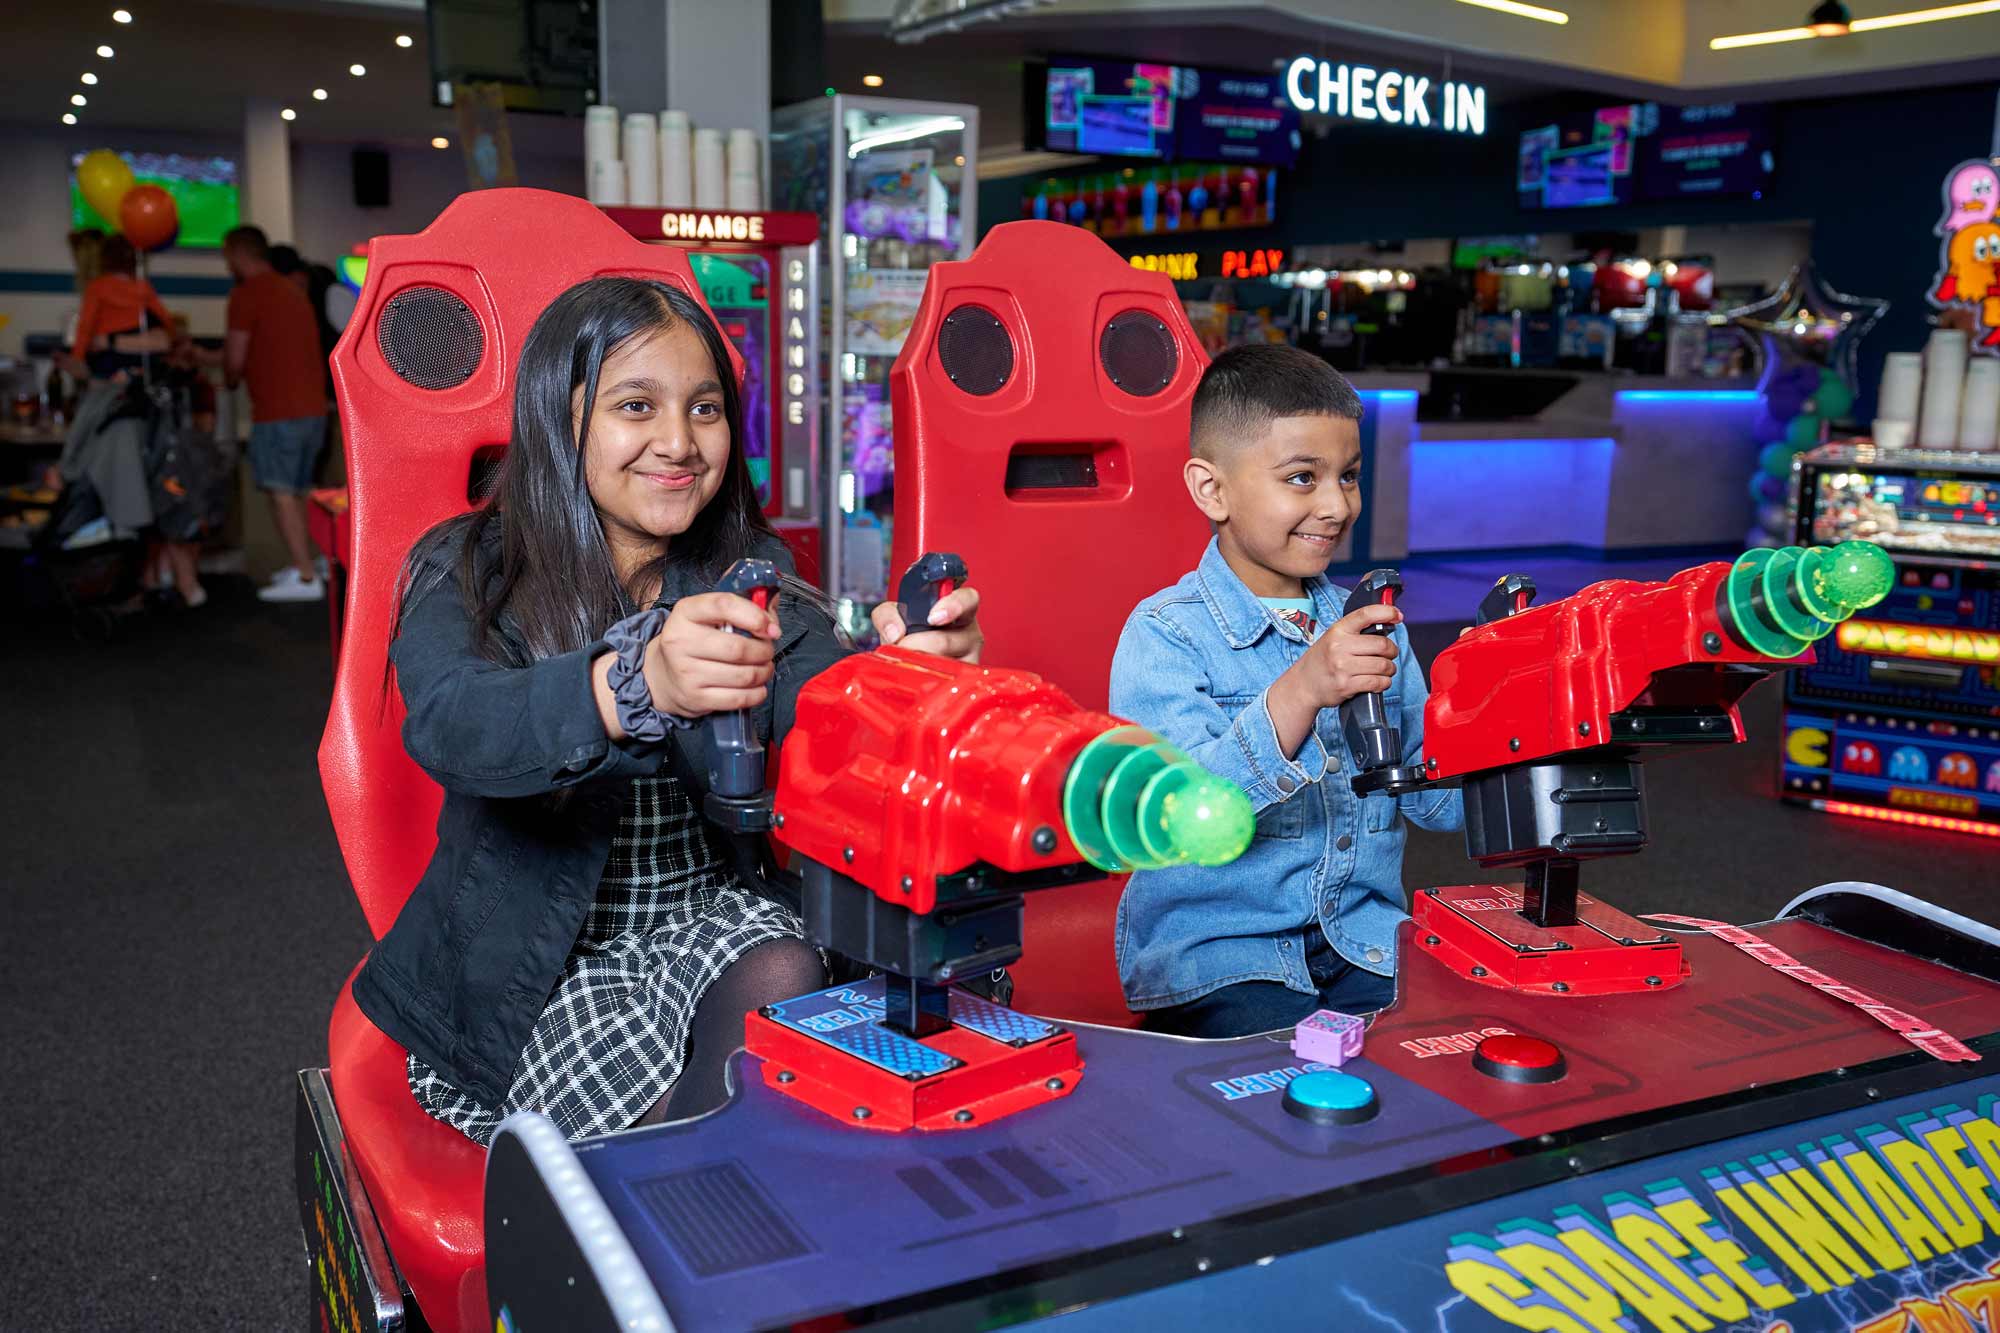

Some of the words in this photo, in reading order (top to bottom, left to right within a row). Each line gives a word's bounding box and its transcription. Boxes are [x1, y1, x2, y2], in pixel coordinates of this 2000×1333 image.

[1287, 57, 1430, 127] CHECK
[1444, 82, 1485, 134] IN
[661, 212, 765, 240] CHANGE
[1221, 249, 1283, 278] PLAY
[788, 260, 804, 424] CHANGE
[1843, 622, 1999, 660] PAC-MAN
[825, 988, 868, 1004] 2
